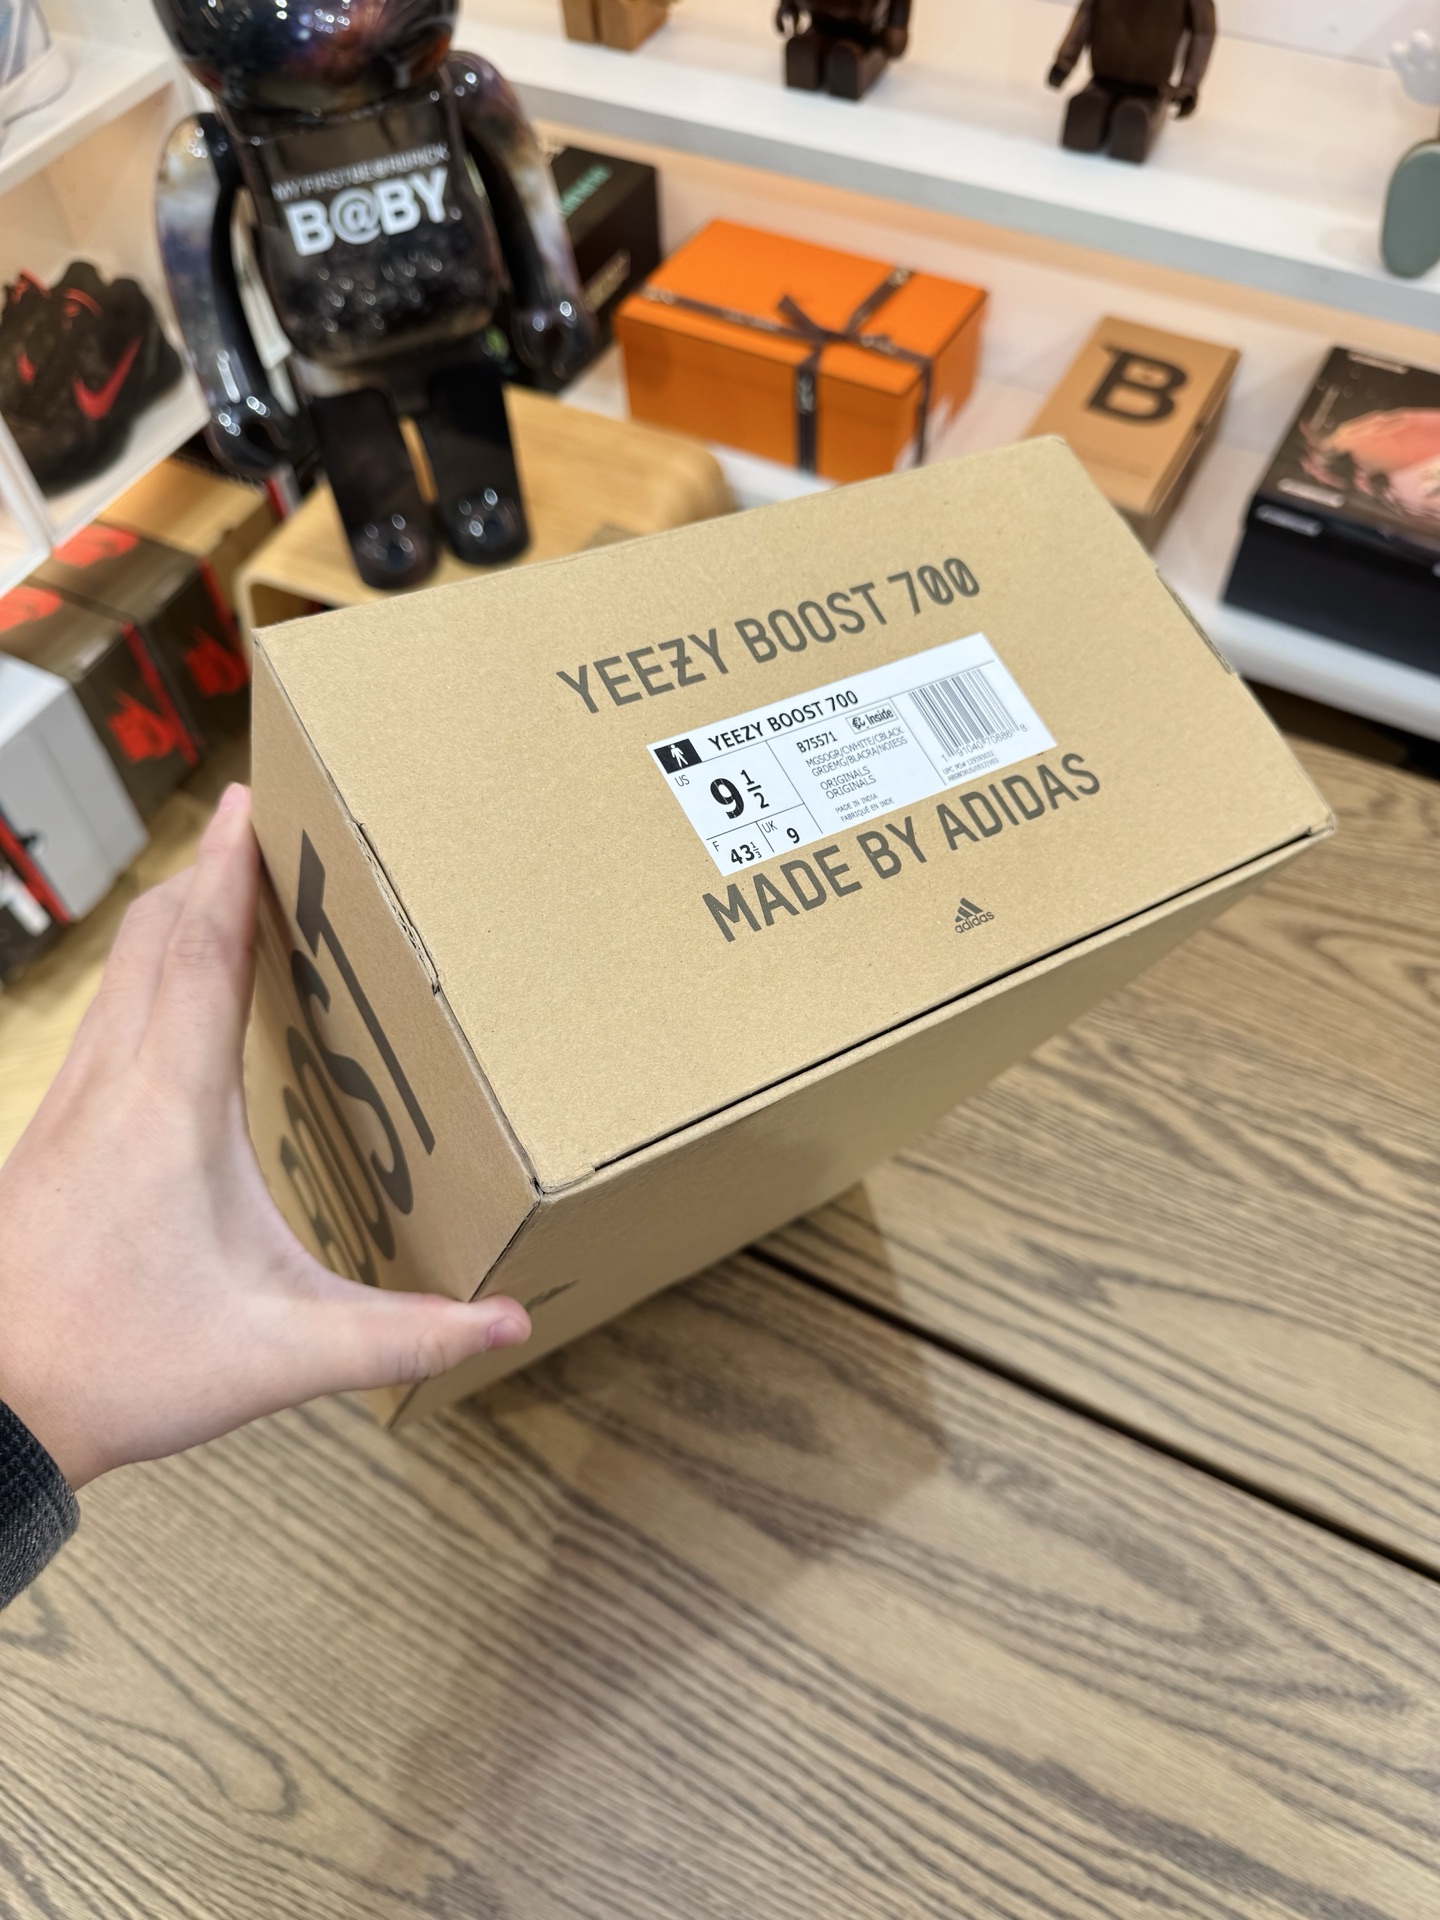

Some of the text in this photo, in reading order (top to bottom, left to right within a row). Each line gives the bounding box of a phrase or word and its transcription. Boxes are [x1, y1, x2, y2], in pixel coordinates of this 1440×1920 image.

[284, 166, 448, 257] B@BY
[1085, 345, 1188, 426] B
[556, 557, 980, 714] YEEZY BOOST 700
[708, 690, 858, 751] YEEZY BOOST 700
[865, 708, 894, 726] Inside
[796, 731, 838, 753] B75571
[675, 774, 690, 787] US
[820, 765, 871, 790] ORIGINALS
[942, 765, 955, 775] UPC
[709, 777, 745, 820] 9
[826, 775, 877, 800] ORIGINALS
[835, 803, 853, 813] MADE
[860, 793, 878, 805] INDIA
[870, 803, 880, 811] EN
[880, 797, 895, 807] INDE
[761, 820, 778, 834] UK
[786, 827, 800, 844] 9
[702, 753, 1101, 943] MADE BY ADIDAS
[712, 840, 720, 852] F
[954, 909, 995, 934] adidas
